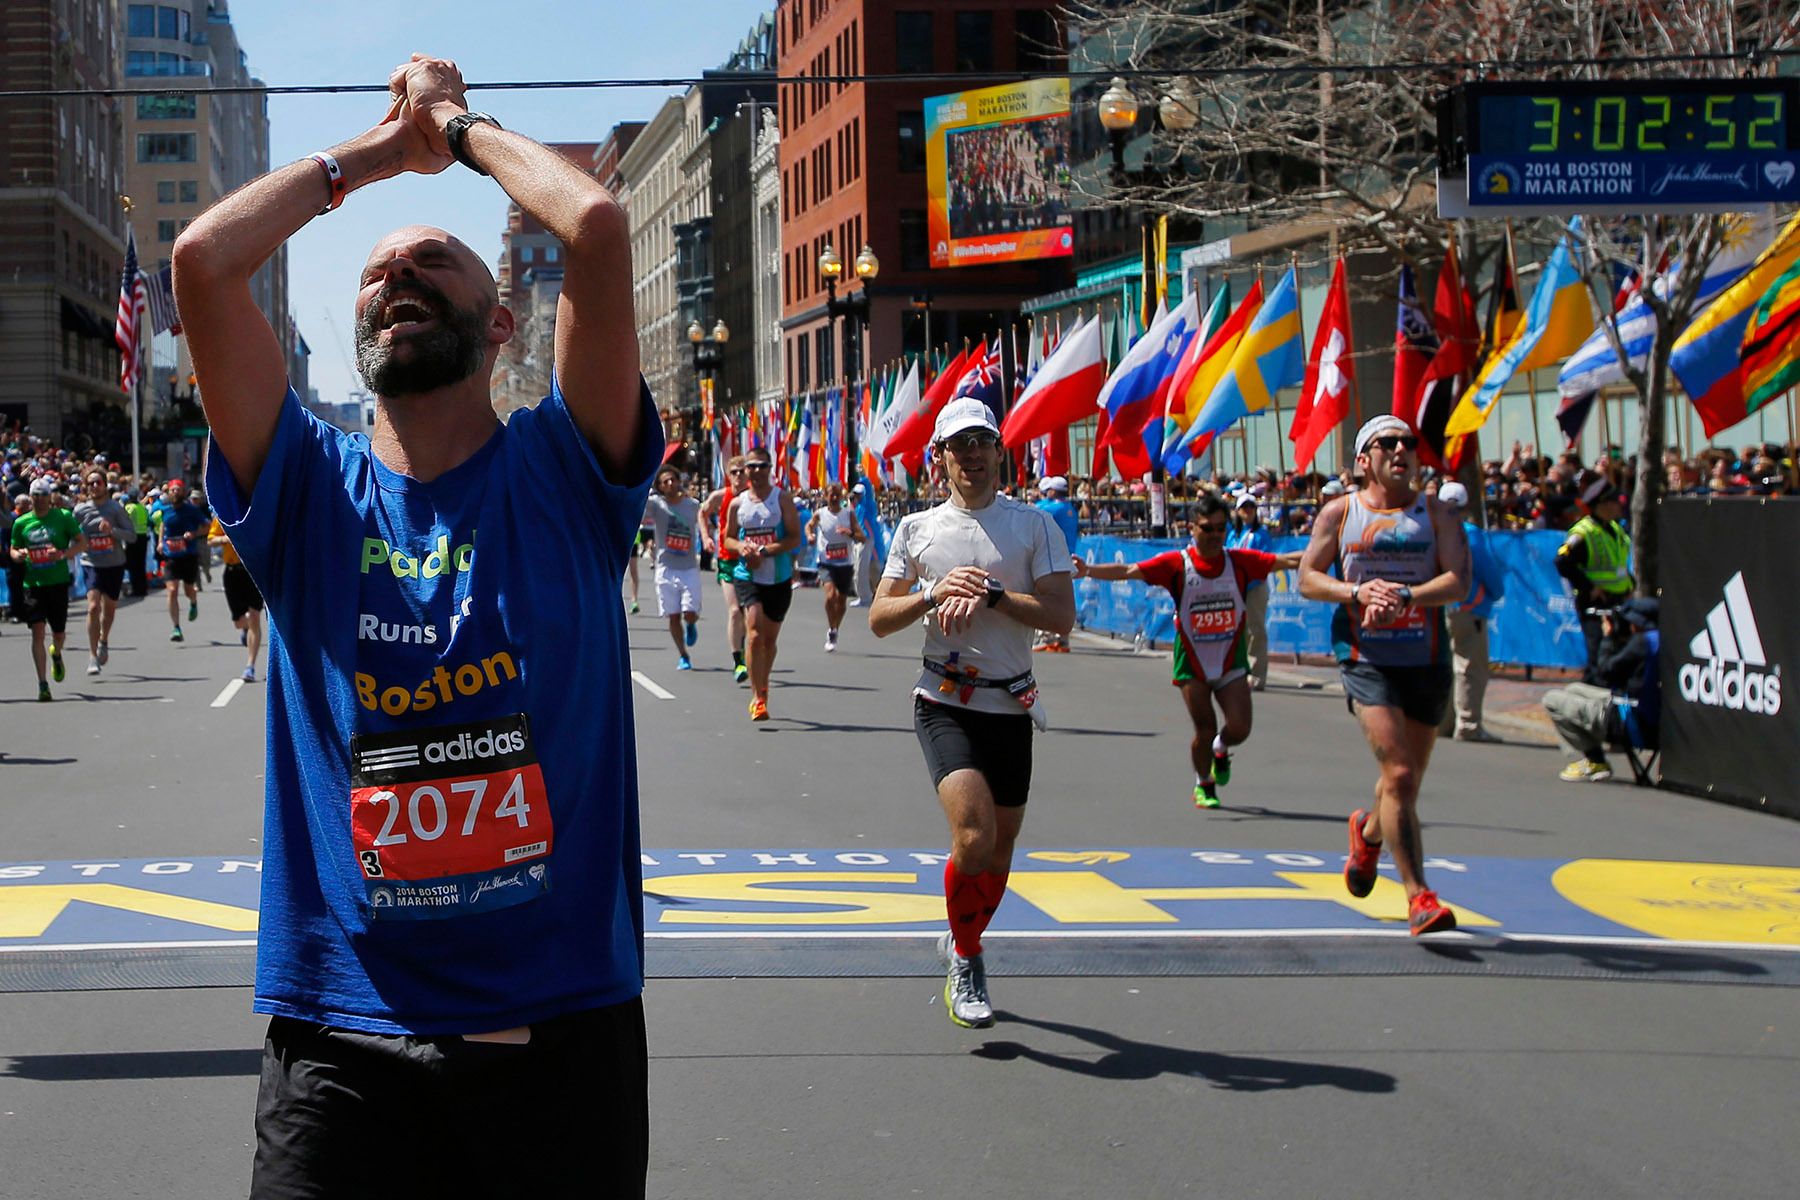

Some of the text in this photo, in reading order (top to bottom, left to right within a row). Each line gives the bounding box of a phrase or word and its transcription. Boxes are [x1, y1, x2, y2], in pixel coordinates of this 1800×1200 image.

[978, 102, 1028, 117] MARATHON
[997, 92, 1027, 105] BOSTON
[1529, 96, 1782, 151] 3:02:52
[1525, 162, 1632, 177] 2014 BOSTON
[1525, 179, 1633, 194] MARATHON
[358, 613, 437, 644] Runs
[1196, 611, 1232, 628] 2953
[355, 651, 518, 716] Boston
[1678, 654, 1782, 716] adidas
[424, 729, 525, 763] adidas
[368, 773, 531, 847] 2074
[361, 850, 382, 877] 3
[396, 884, 458, 896] 2014 BOSTON
[396, 895, 460, 907] MARATHON
